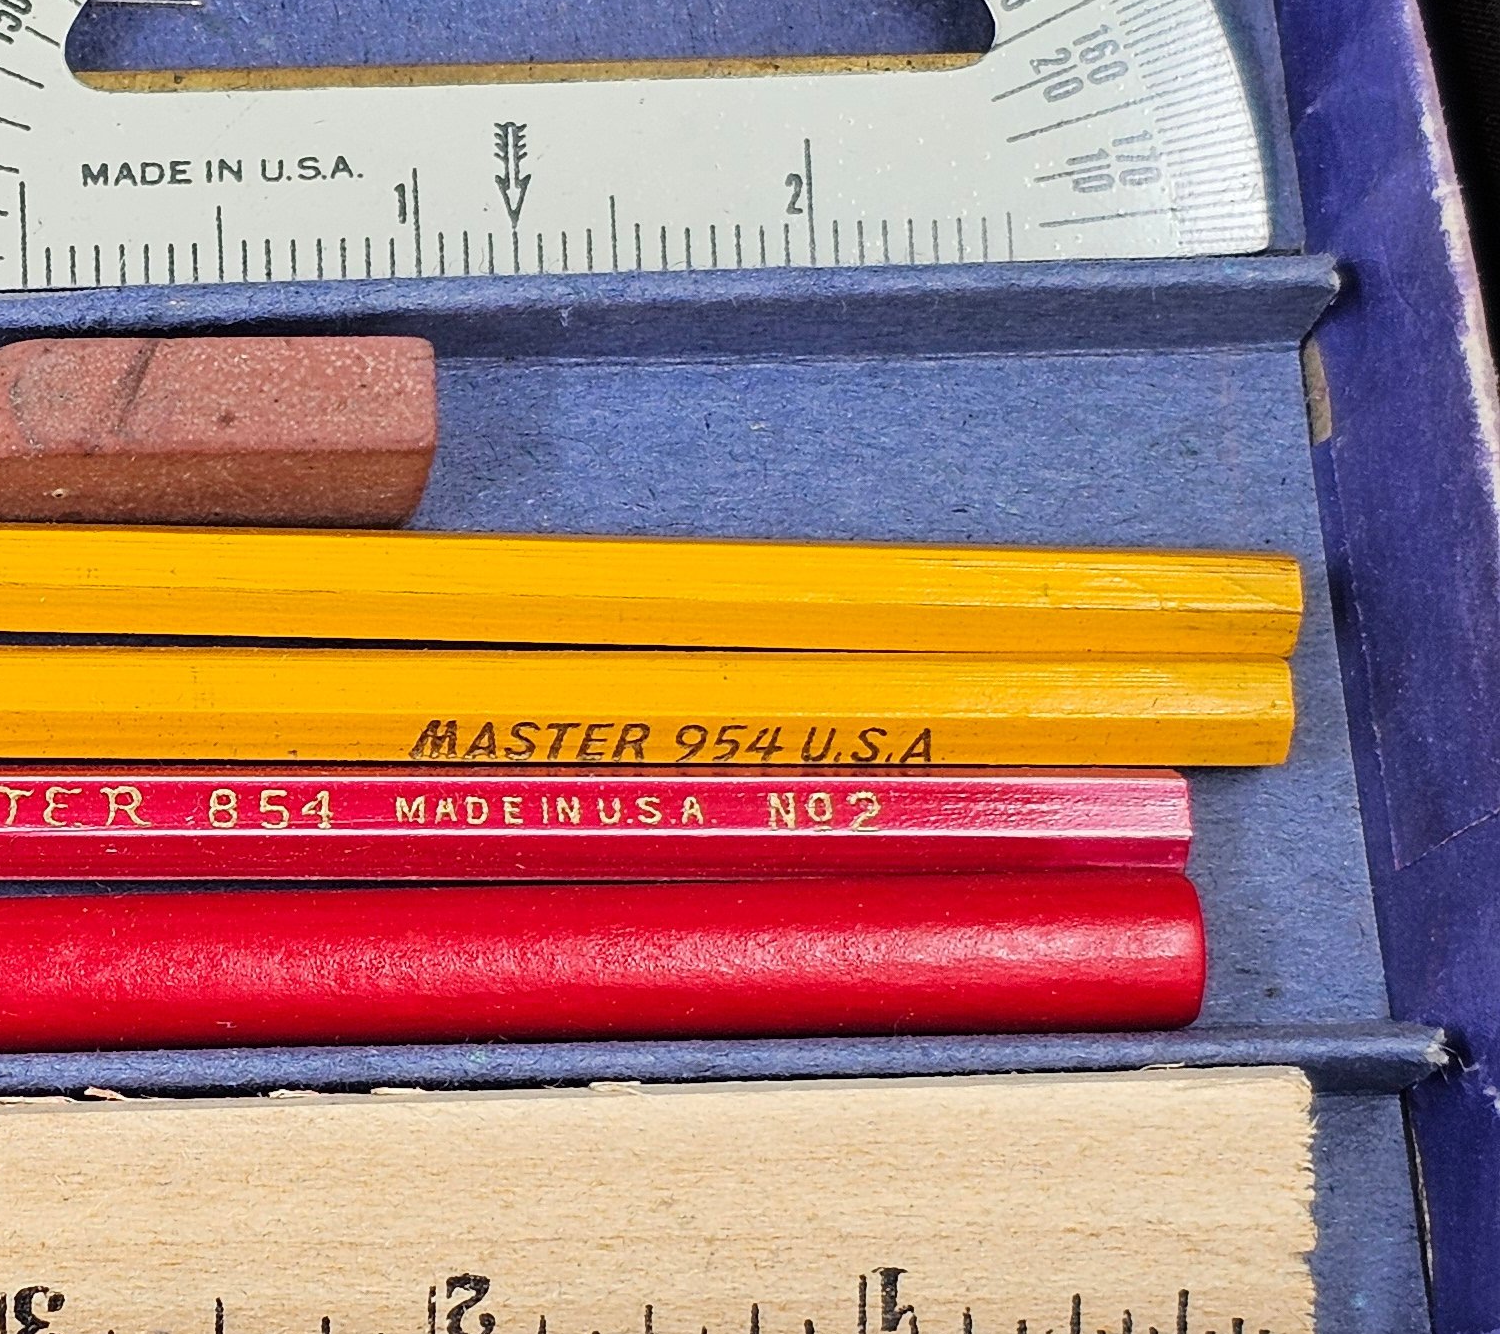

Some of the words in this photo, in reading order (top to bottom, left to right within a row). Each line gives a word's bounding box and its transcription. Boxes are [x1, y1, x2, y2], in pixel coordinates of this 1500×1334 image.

[1029, 47, 1084, 103] 20
[1072, 24, 1129, 85] 160
[81, 160, 193, 187] MADE
[206, 158, 243, 183] IN
[260, 155, 364, 182] U.S.A.
[1066, 148, 1115, 193] 10
[1112, 130, 1161, 187] 170
[393, 183, 407, 224] 1
[785, 173, 803, 215] 2
[408, 720, 650, 761] MASTER
[675, 724, 783, 762] 954
[209, 788, 334, 830] 854
[395, 795, 524, 826] MADE
[541, 796, 581, 825] IN
[846, 791, 881, 832] 2
[871, 1267, 915, 1332] 1
